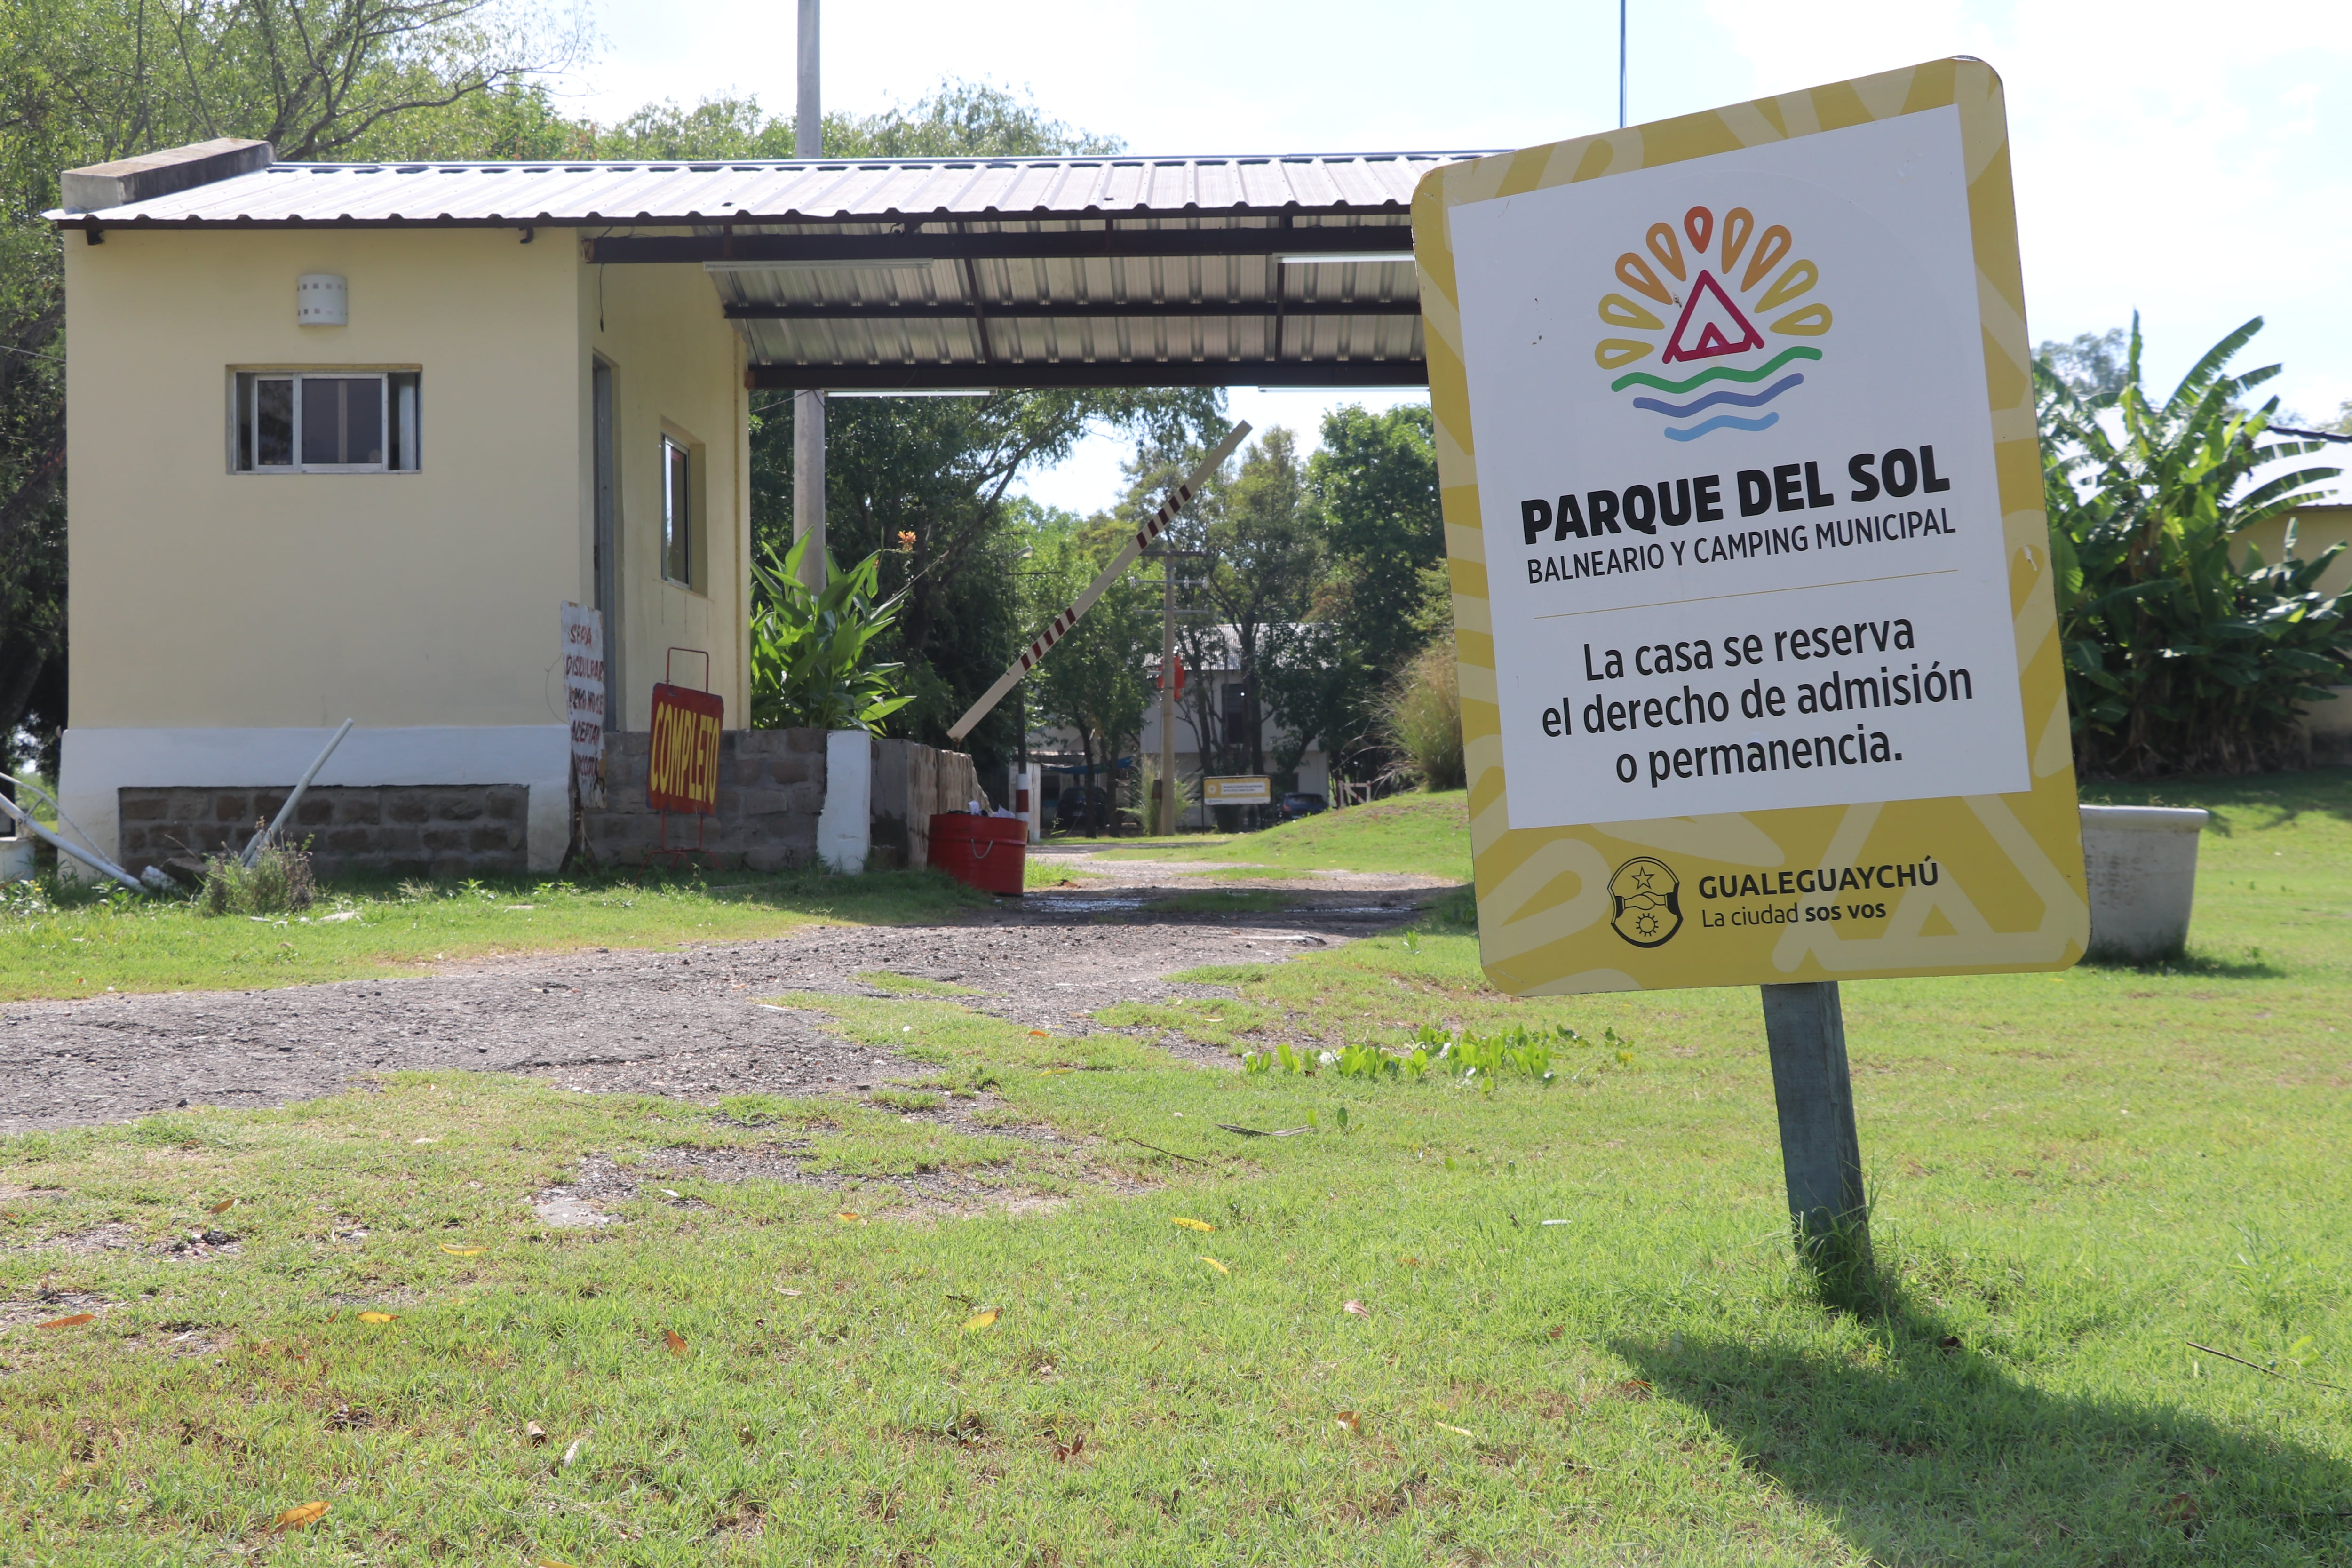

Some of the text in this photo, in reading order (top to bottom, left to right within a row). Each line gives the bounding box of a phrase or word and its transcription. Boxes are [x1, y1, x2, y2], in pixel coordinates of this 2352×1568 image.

[1520, 444, 1951, 545] PARQUE DEL SOL
[1527, 507, 1956, 584] BALNEARIO Y CAMPING MUNICIPAL
[1583, 618, 1915, 682] La casa se reserva
[1542, 660, 1973, 738] el derecho de admisión
[651, 701, 719, 804] COMPLETO
[1615, 723, 1903, 788] o permanencia.
[1699, 855, 1939, 899] GUALEGUAYCHÚ
[1702, 902, 1886, 928] La ciudad sos vos
